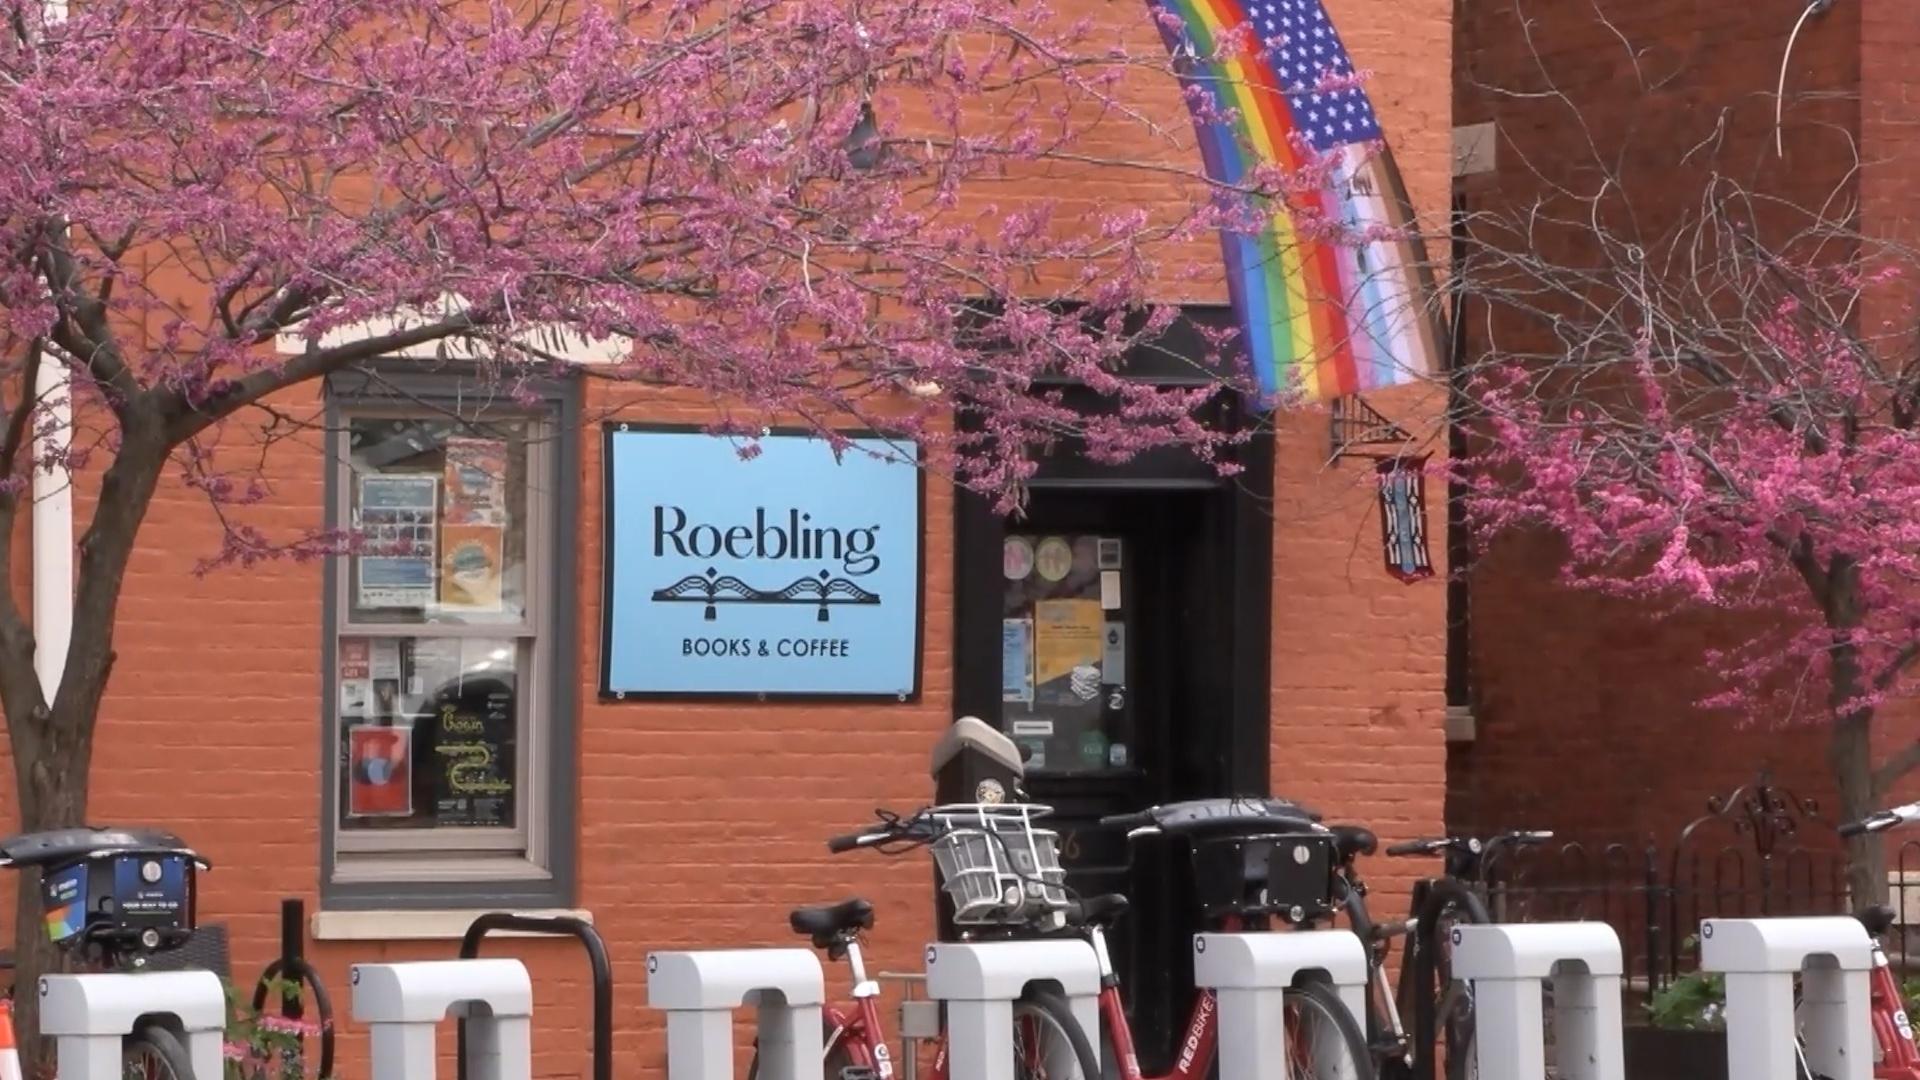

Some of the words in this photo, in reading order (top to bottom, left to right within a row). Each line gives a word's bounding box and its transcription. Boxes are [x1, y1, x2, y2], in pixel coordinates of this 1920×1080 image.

[653, 504, 881, 577] Roebling
[682, 637, 751, 657] BOOKS
[758, 638, 770, 657] &
[776, 638, 850, 657] COFFEE
